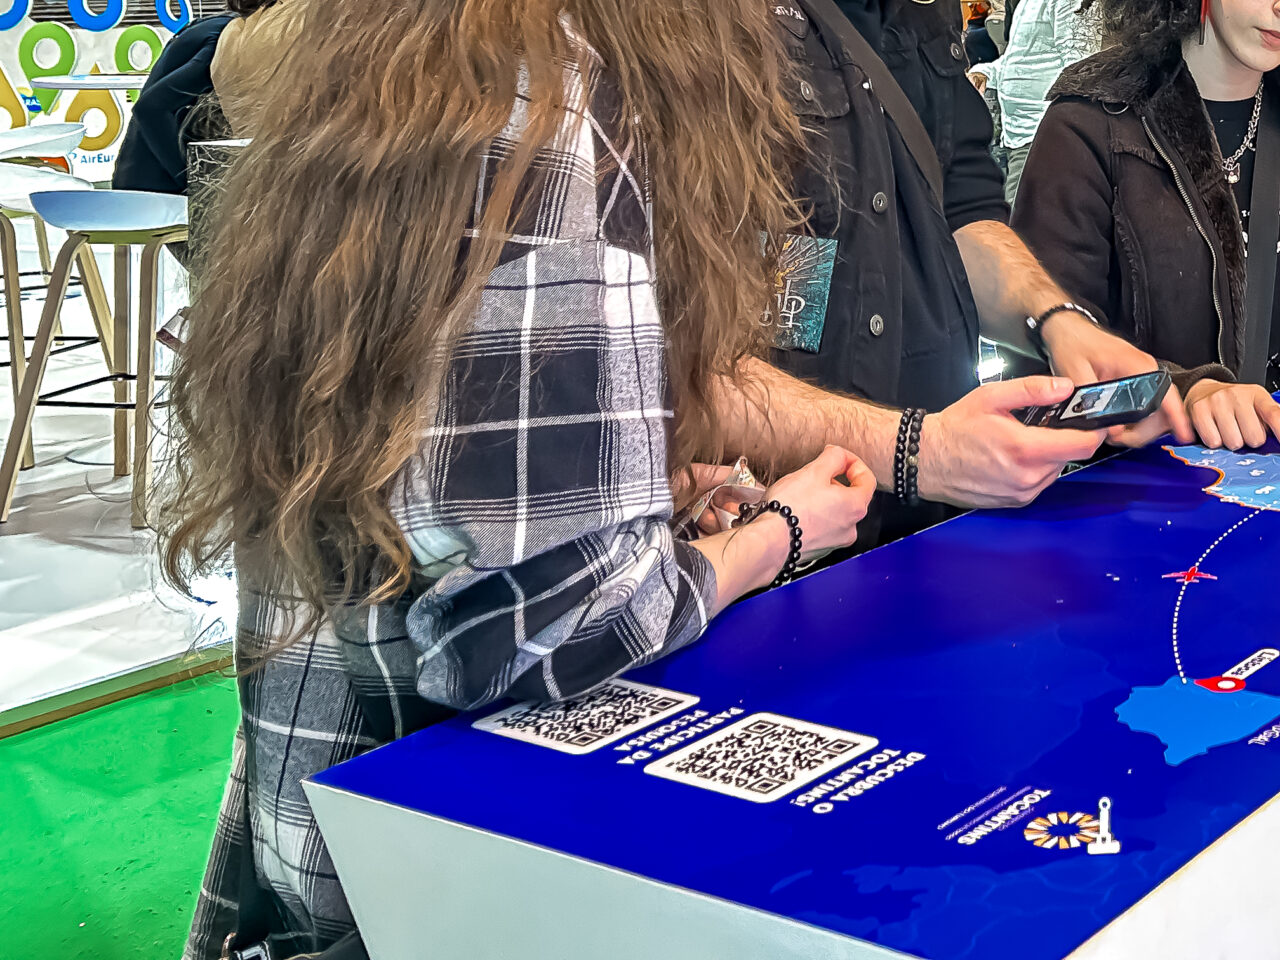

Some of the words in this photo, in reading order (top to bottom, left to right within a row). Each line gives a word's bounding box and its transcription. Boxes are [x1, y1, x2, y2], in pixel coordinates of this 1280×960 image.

[612, 709, 710, 751] PESQUISA
[648, 706, 745, 752] PARTICIPE
[616, 749, 653, 765] DA
[829, 751, 927, 802] DESCUBRA
[812, 801, 834, 814] O
[956, 789, 1052, 846] TOCANTINS
